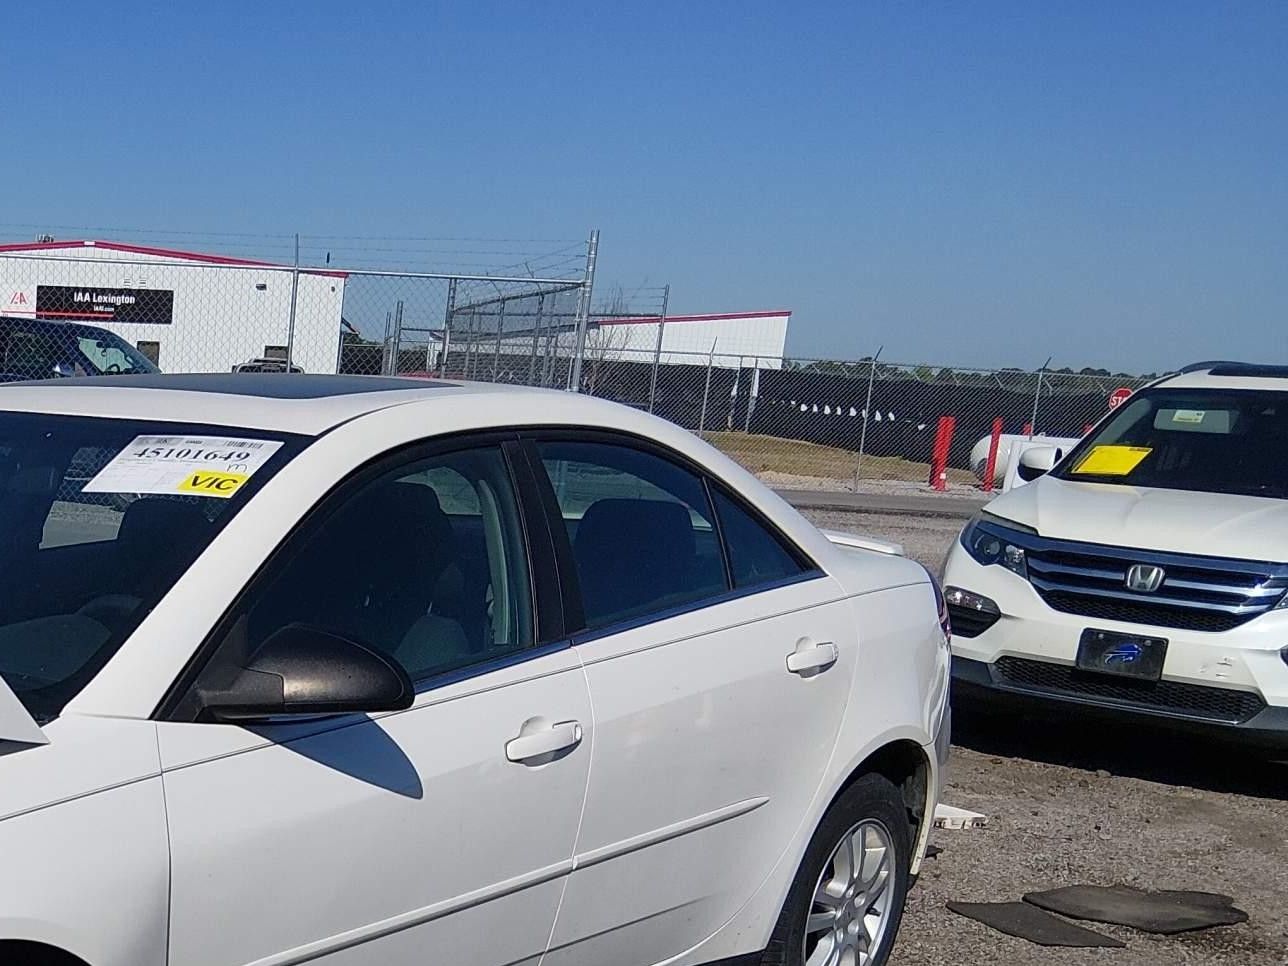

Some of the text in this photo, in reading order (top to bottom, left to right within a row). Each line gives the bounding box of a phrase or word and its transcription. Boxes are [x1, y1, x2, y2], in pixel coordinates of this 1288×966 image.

[73, 291, 136, 306] IAA Lexington
[133, 447, 251, 462] 45101649
[191, 475, 239, 491] VIC
